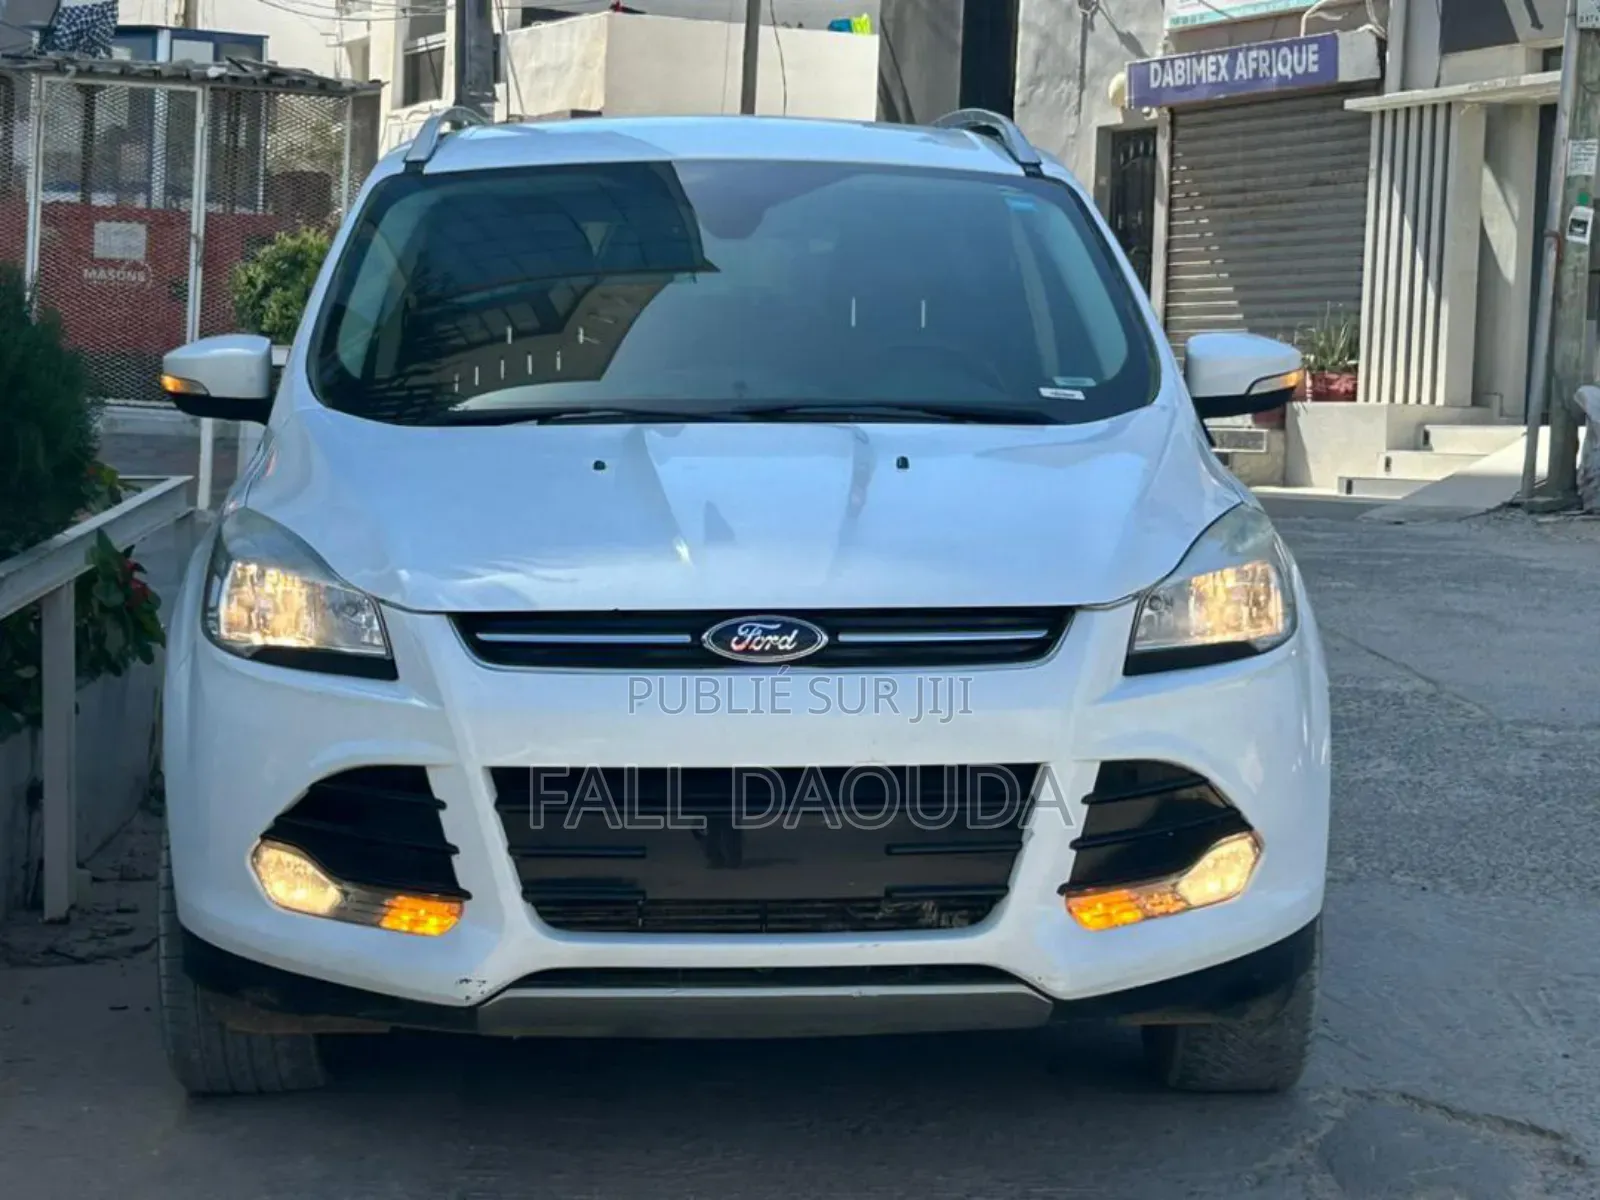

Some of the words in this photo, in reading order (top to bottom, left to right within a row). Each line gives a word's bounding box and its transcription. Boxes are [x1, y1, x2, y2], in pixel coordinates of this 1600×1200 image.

[1150, 54, 1229, 88] DABIMEX
[1234, 43, 1319, 80] AFRIQUE
[730, 622, 799, 652] Ford
